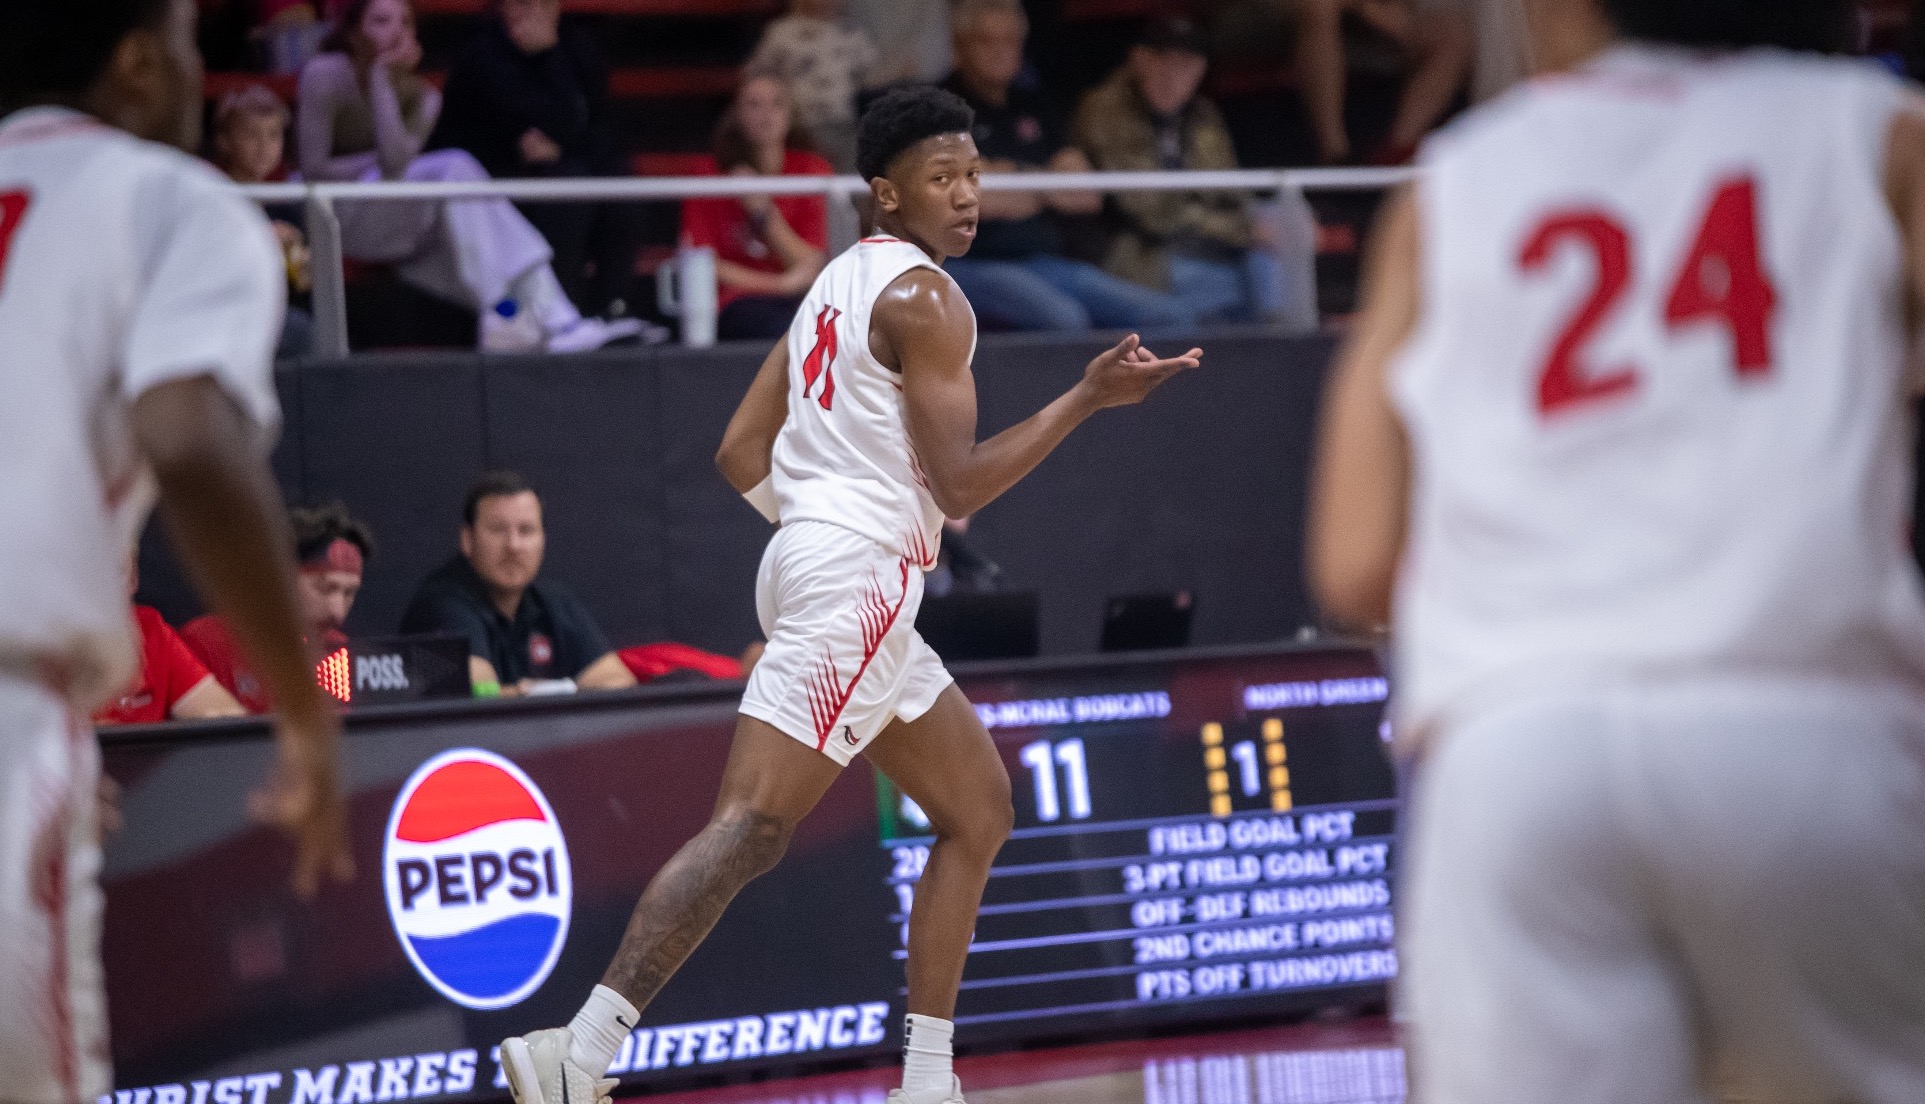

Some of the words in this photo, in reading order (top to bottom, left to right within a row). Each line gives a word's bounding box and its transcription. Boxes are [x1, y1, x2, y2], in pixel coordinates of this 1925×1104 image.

[1516, 170, 1777, 414] 24
[356, 653, 409, 691] POSS.
[1244, 681, 1318, 710] NORTH
[1319, 676, 1388, 706] GREEN
[973, 698, 1071, 728] S-MCRAE
[1073, 691, 1172, 722] BOBCATS
[1020, 737, 1092, 822] 11
[1231, 740, 1260, 797] 1
[1149, 822, 1227, 856] FIELD
[1228, 816, 1301, 849] GOAL
[1302, 810, 1354, 844] PCT
[397, 847, 557, 910] PEPSI
[1123, 860, 1184, 893] 3-PT
[1184, 854, 1261, 889] FIELD
[1262, 848, 1335, 881] GOAL
[1335, 842, 1389, 876] PCT
[1249, 879, 1390, 916] REBOUNDS
[1133, 933, 1190, 964] 2ND
[1191, 922, 1299, 958] CHANCE
[1300, 912, 1394, 947] POINTS
[1136, 968, 1191, 1001] PTS
[1192, 963, 1247, 995] OFF
[288, 1048, 479, 1104] MAKES
